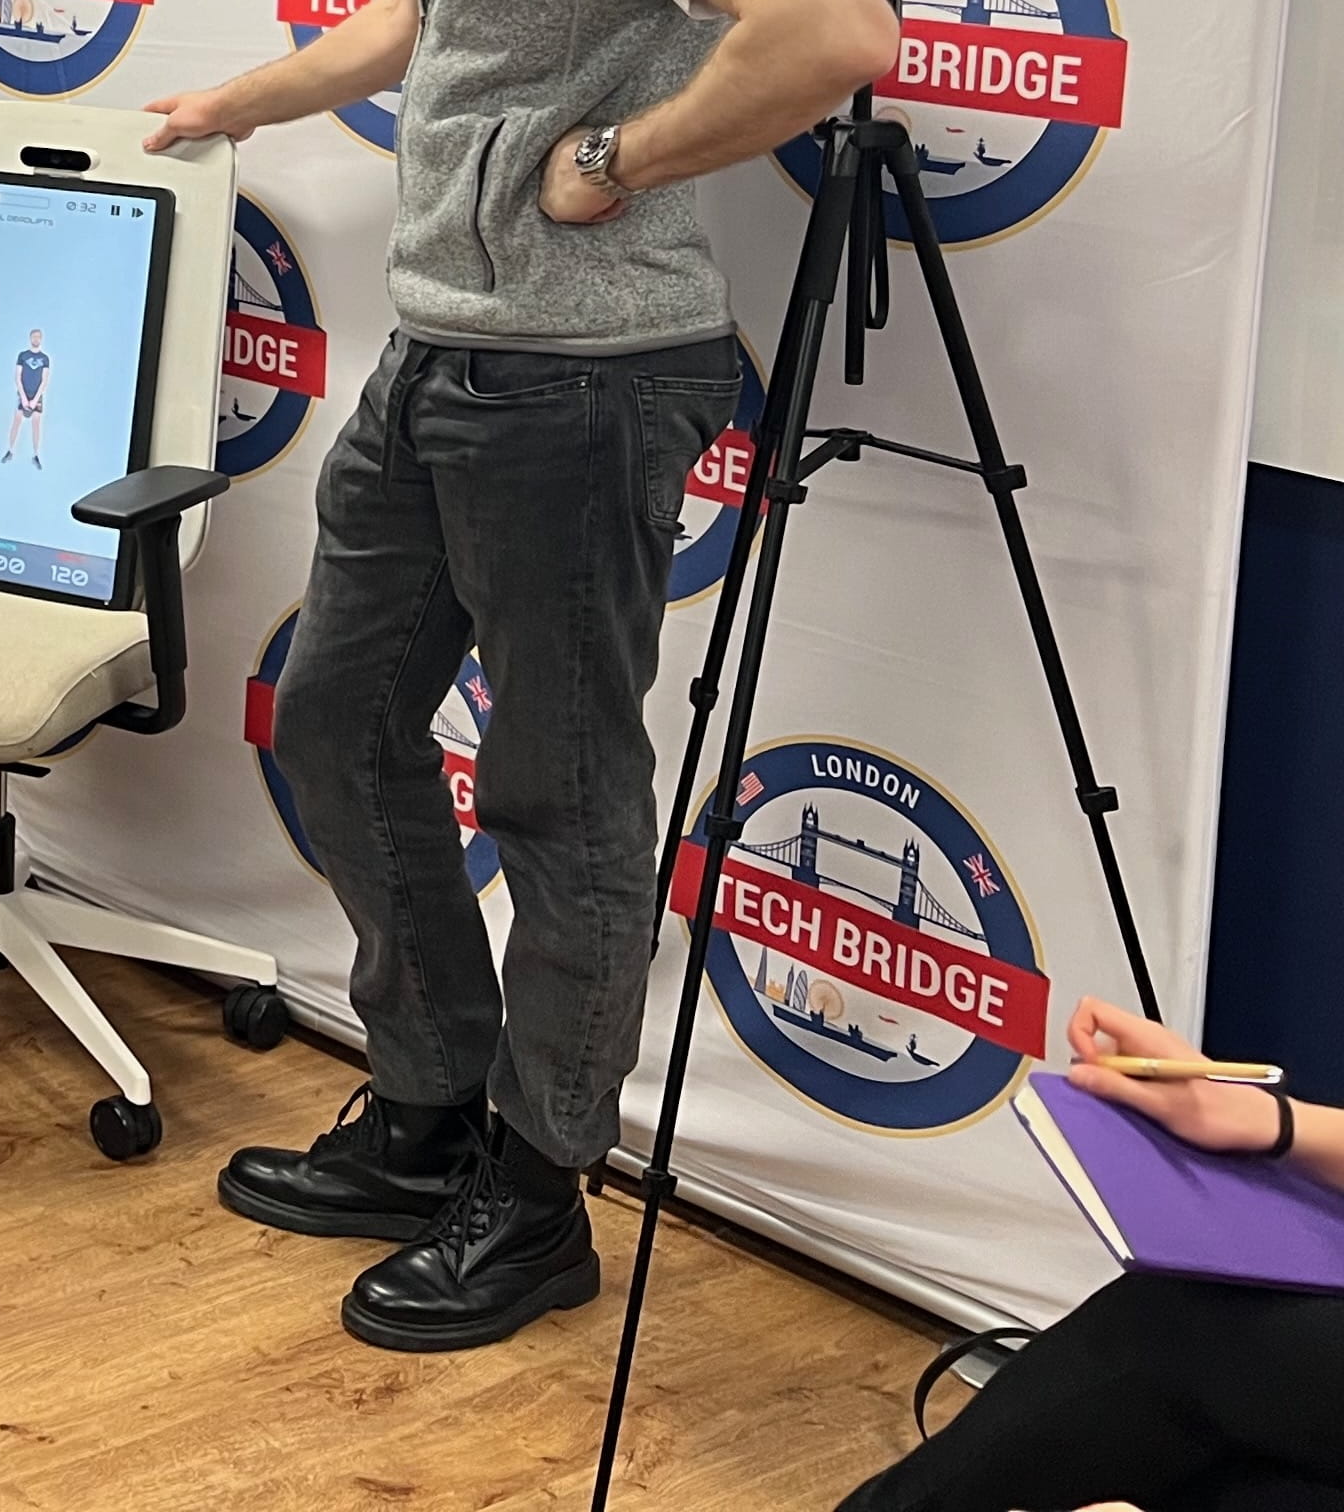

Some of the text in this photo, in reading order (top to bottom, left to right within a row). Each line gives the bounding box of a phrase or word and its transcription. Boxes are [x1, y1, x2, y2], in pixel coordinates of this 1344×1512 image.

[897, 37, 1083, 105] BRIDGE
[224, 325, 299, 378] IDGE
[50, 565, 89, 586] 120
[811, 753, 921, 808] LONDON
[714, 874, 1009, 1027] TECH BRIDGE
